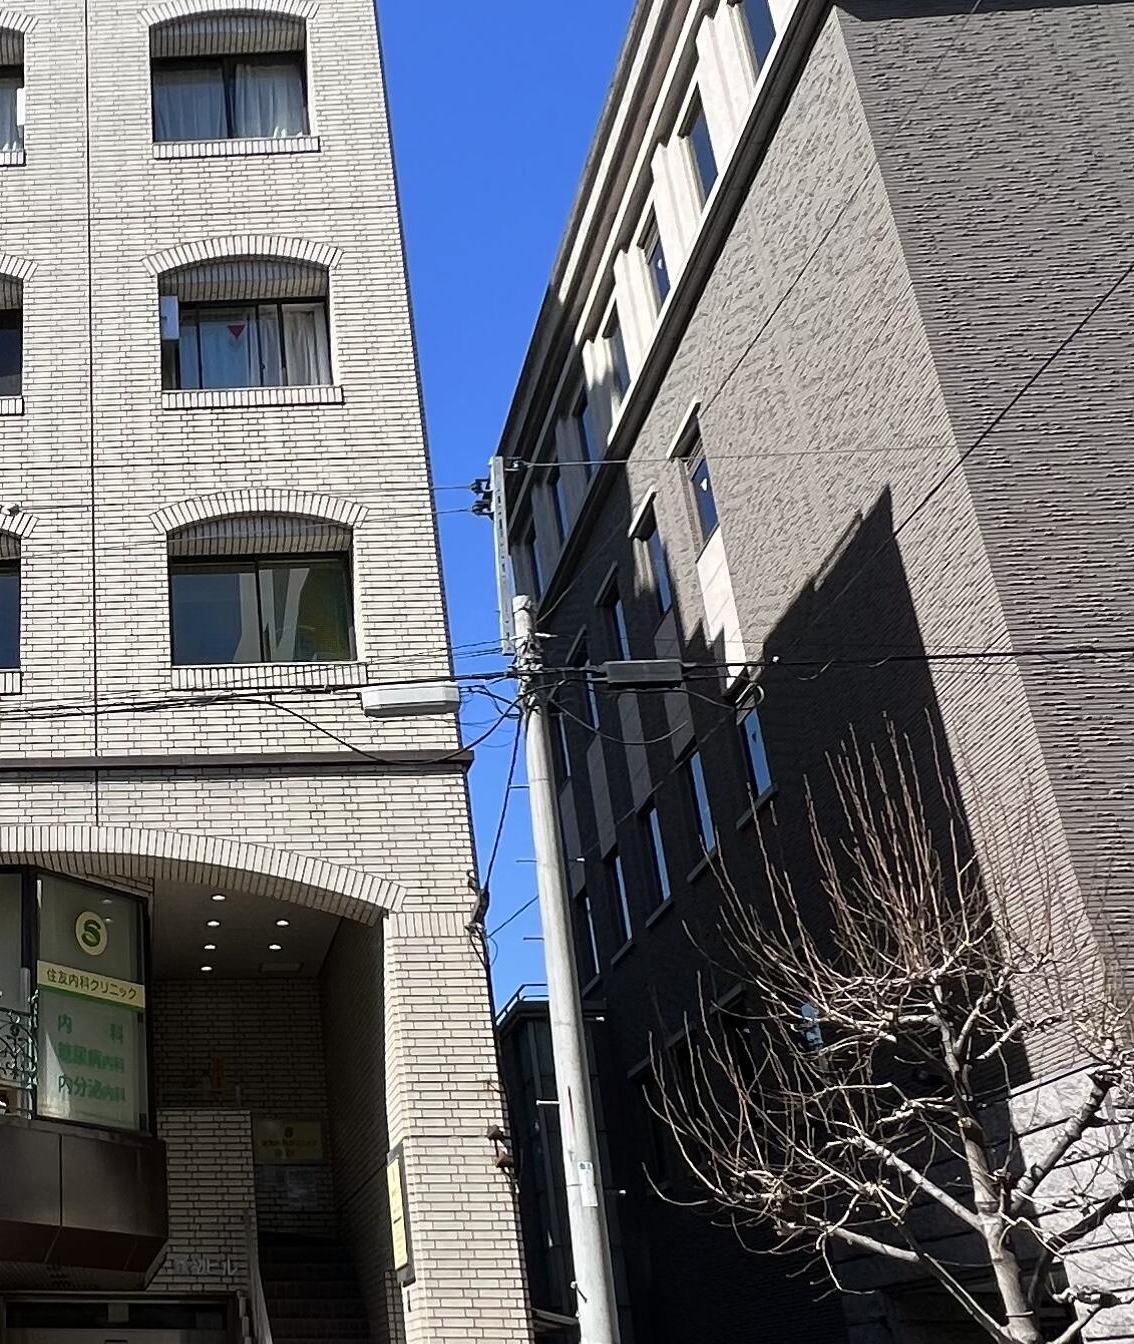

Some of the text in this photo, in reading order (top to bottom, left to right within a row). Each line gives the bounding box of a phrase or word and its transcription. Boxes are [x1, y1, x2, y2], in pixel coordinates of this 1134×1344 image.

[82, 919, 102, 948] S
[46, 968, 137, 1000] 住友内科クリニック
